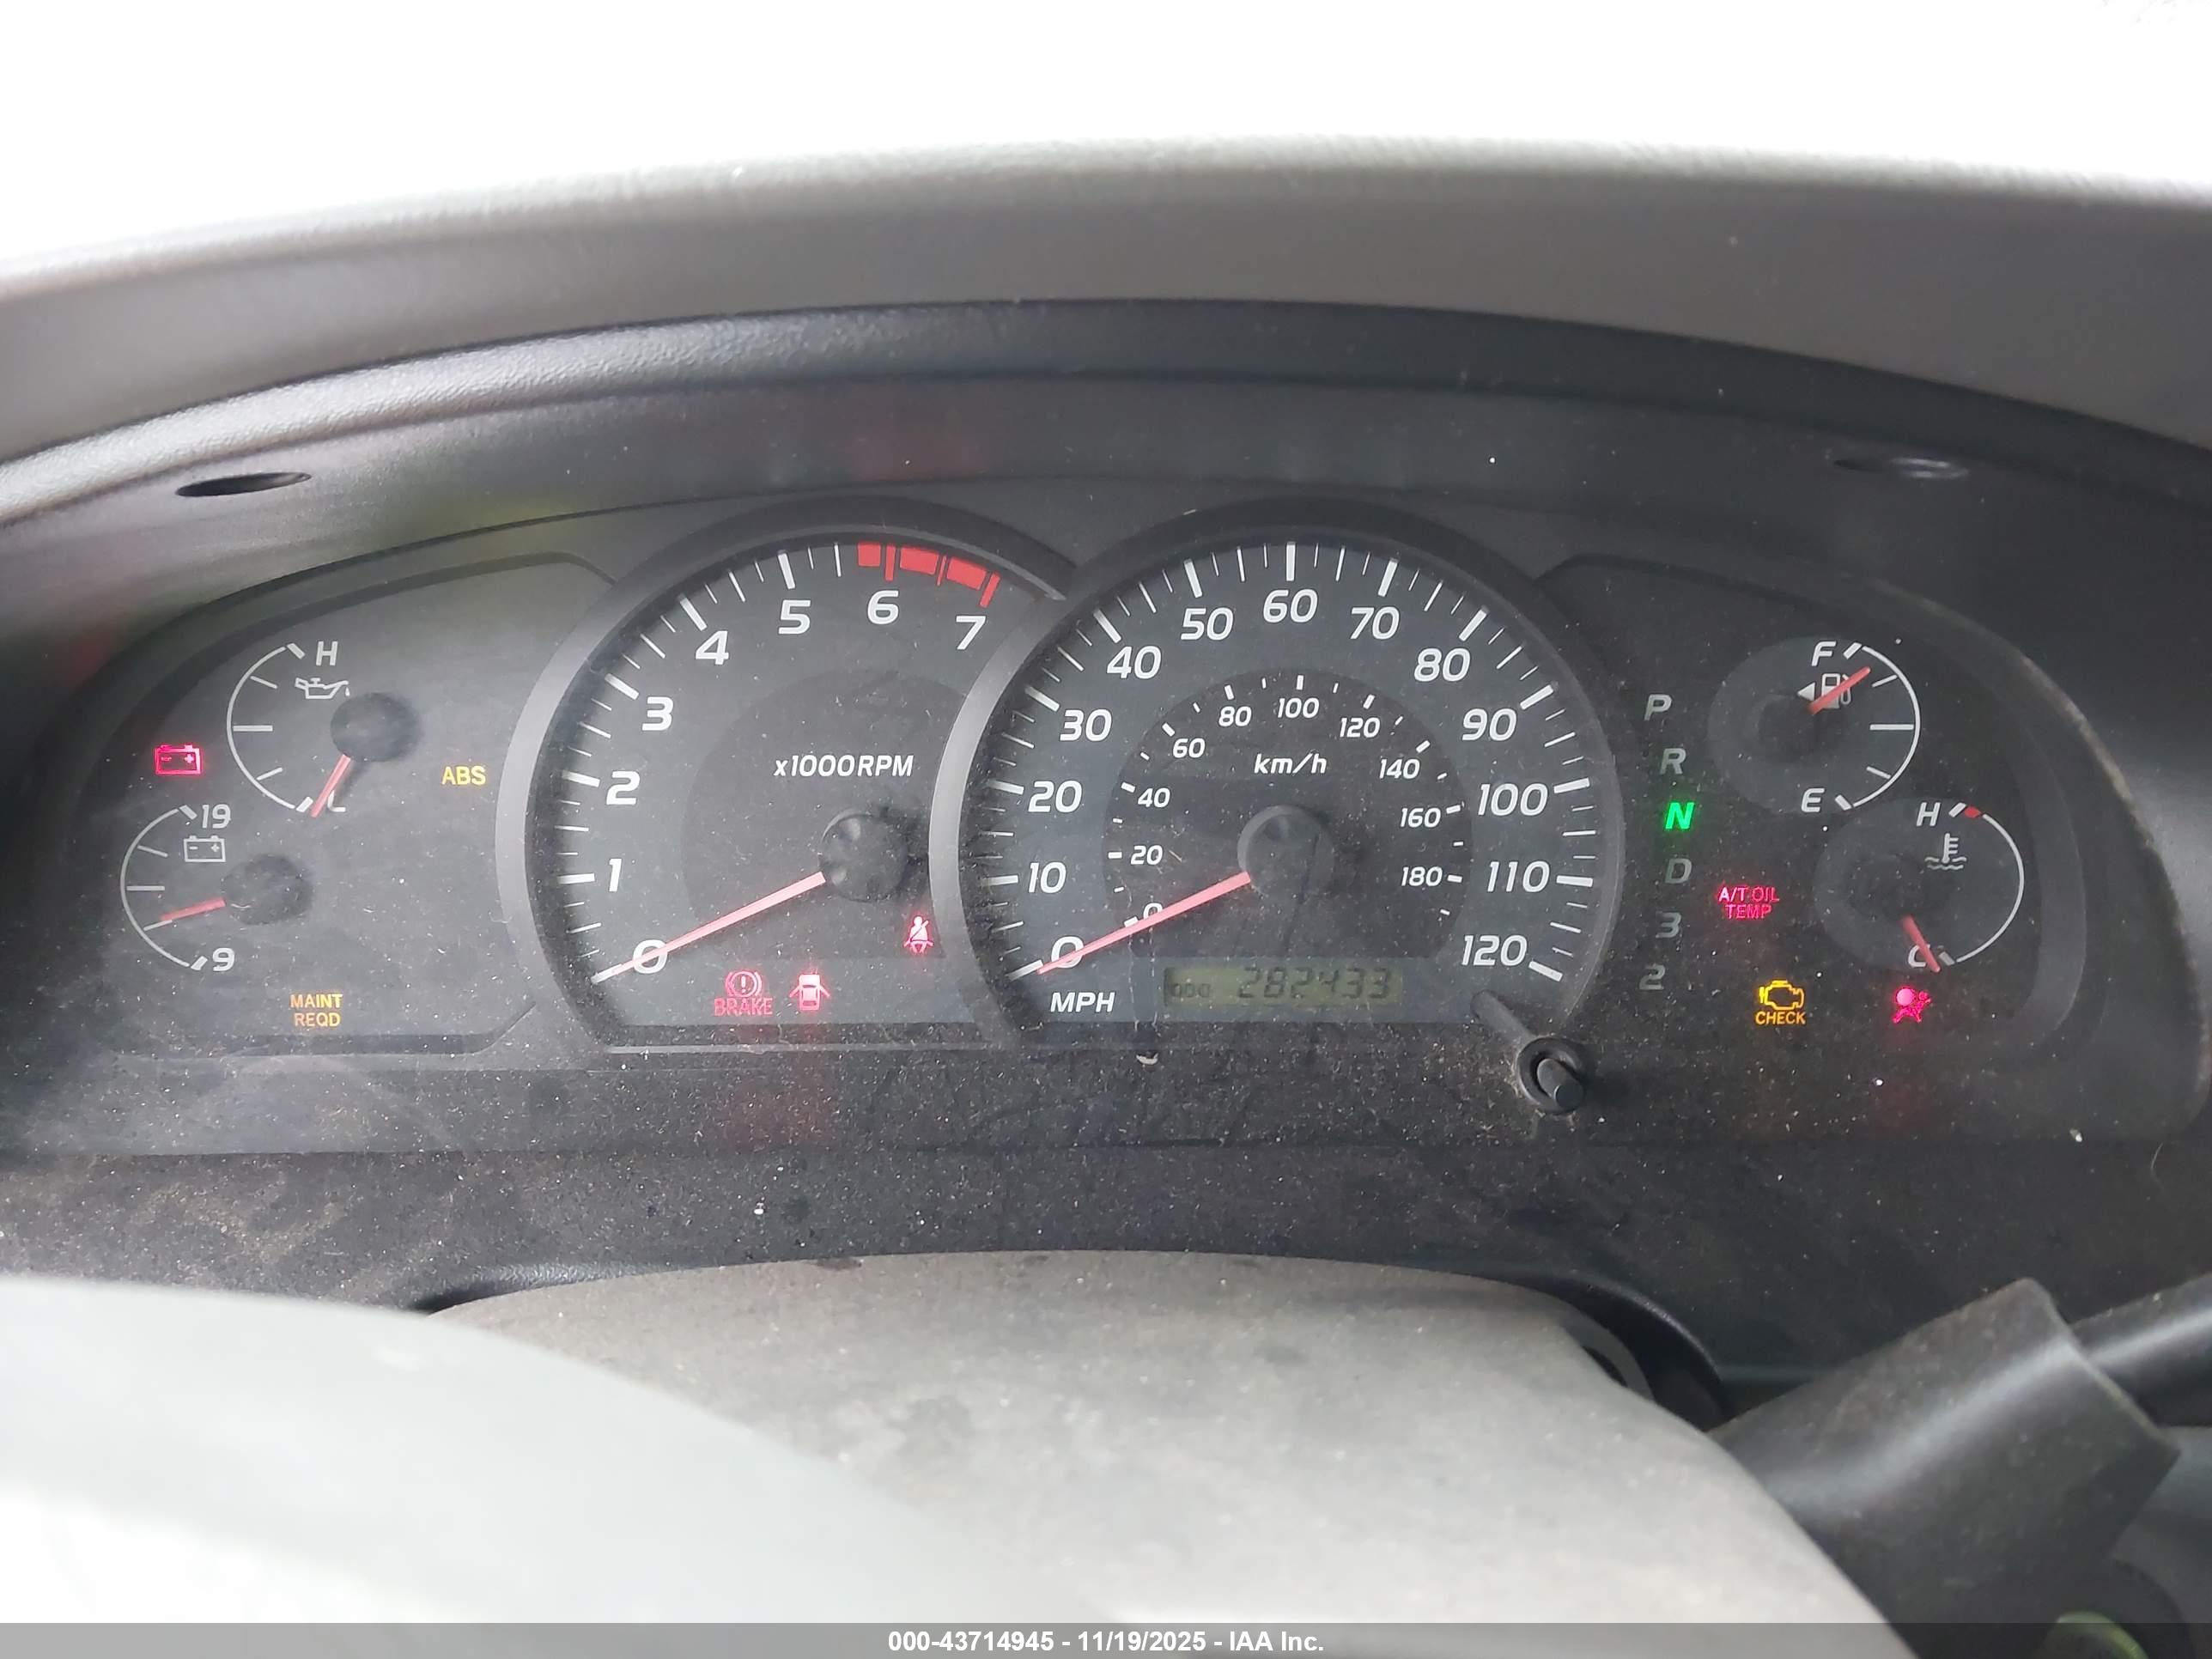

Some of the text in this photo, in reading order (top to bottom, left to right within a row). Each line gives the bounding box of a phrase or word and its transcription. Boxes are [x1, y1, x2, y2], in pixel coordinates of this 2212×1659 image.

[778, 600, 811, 634] 5
[867, 590, 899, 623] 6
[1263, 589, 1318, 623] 60
[956, 616, 986, 650] 7
[1181, 608, 1233, 641] 50
[1350, 606, 1400, 640] 70
[316, 641, 337, 665] H
[696, 631, 729, 665] 4
[1812, 641, 1837, 666] F
[1107, 646, 1161, 679] 40
[1413, 647, 1471, 682] 80
[642, 696, 673, 731] 3
[1218, 706, 1251, 726] 80
[1278, 698, 1319, 718] 100
[1644, 695, 1672, 720] P
[1060, 708, 1112, 741] 30
[1340, 717, 1380, 738] 120
[1462, 708, 1517, 741] 90
[1172, 738, 1206, 758] 60
[1254, 753, 1327, 775] km/h
[1379, 758, 1419, 779] 140
[1660, 748, 1687, 775] R
[442, 766, 487, 785] ABS
[606, 771, 641, 805] 2
[1028, 781, 1082, 812] 20
[1138, 787, 1170, 808] 40
[1478, 783, 1548, 816] 100
[1801, 787, 1826, 812] E
[201, 805, 231, 829] 19
[1401, 807, 1441, 828] 160
[1665, 802, 1694, 830] N
[1916, 802, 1941, 827] H
[1130, 846, 1163, 866] 20
[609, 859, 622, 891] 1
[1027, 862, 1066, 894] 10
[1401, 866, 1443, 887] 180
[1486, 861, 1549, 893] 110
[1665, 859, 1692, 884] D
[1718, 886, 1779, 902] A/T OIL
[1725, 903, 1771, 920] TEMP
[1656, 912, 1682, 939] 3
[213, 948, 235, 971] 9
[632, 939, 668, 974] 0
[1051, 936, 1084, 969] 0
[1462, 934, 1528, 968] 120
[1237, 968, 1391, 999] 282433
[1639, 965, 1666, 991] 2
[290, 994, 343, 1009] MAINT
[714, 998, 772, 1016] BRAKE
[1050, 992, 1115, 1013] MPH
[295, 1013, 341, 1027] REQD
[1755, 1012, 1806, 1025] CHECK
